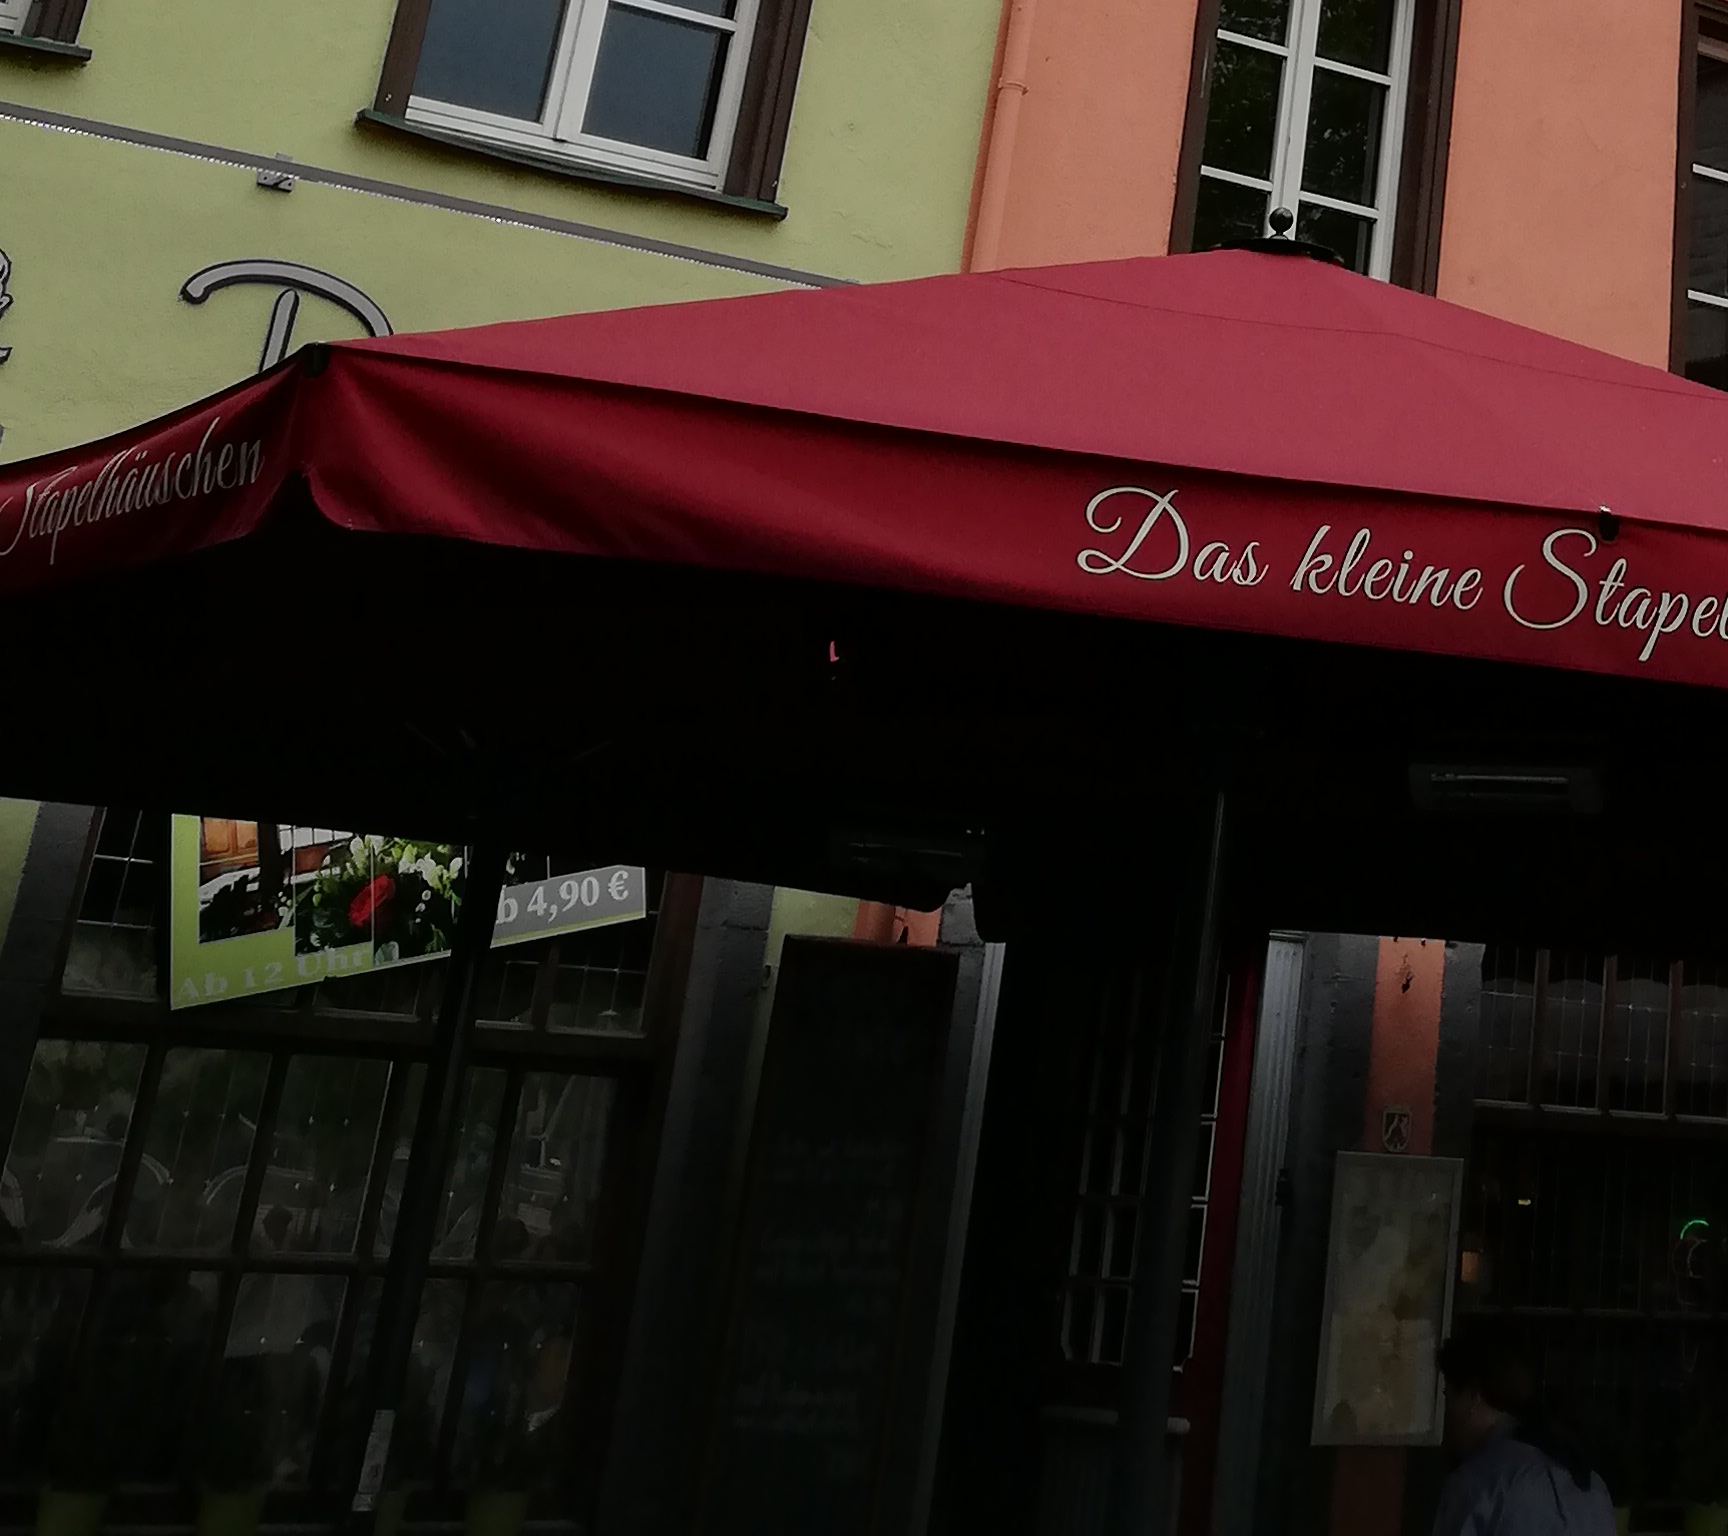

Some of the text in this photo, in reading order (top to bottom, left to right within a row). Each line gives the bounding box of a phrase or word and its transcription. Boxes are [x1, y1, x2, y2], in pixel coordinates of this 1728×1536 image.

[1076, 485, 1270, 586] Das
[1288, 524, 1484, 611] kleine
[526, 876, 600, 924] 4,90
[607, 870, 630, 901] €
[178, 946, 370, 1000] Ab 12 Uhr
